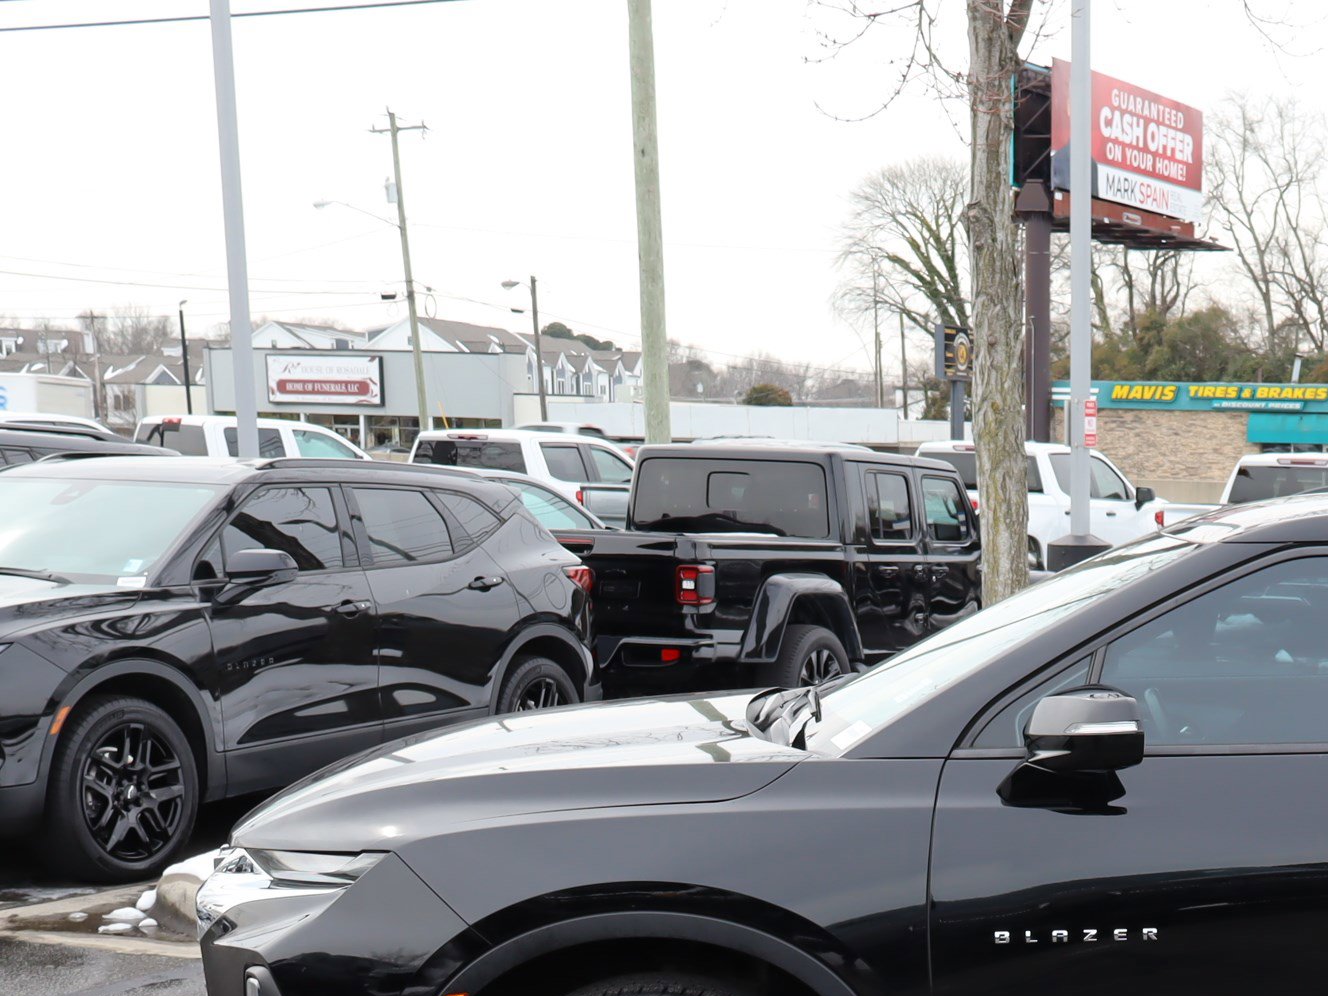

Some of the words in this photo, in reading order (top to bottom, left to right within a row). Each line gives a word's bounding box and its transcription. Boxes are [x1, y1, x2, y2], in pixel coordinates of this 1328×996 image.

[1111, 88, 1184, 128] GUARANTEED
[1100, 106, 1144, 148] CASH
[1146, 121, 1193, 164] OFFER
[1106, 142, 1122, 163] ON
[1125, 148, 1153, 172] YOUR
[1156, 157, 1187, 182] HOME!
[1105, 172, 1137, 203] MARK
[1138, 181, 1170, 210] SPAIN
[1111, 385, 1178, 400] MAVIS
[1188, 385, 1239, 398] TIRES
[1241, 388, 1253, 398] &
[1256, 387, 1328, 399] BRAKES
[994, 927, 1159, 945] BLAZER
